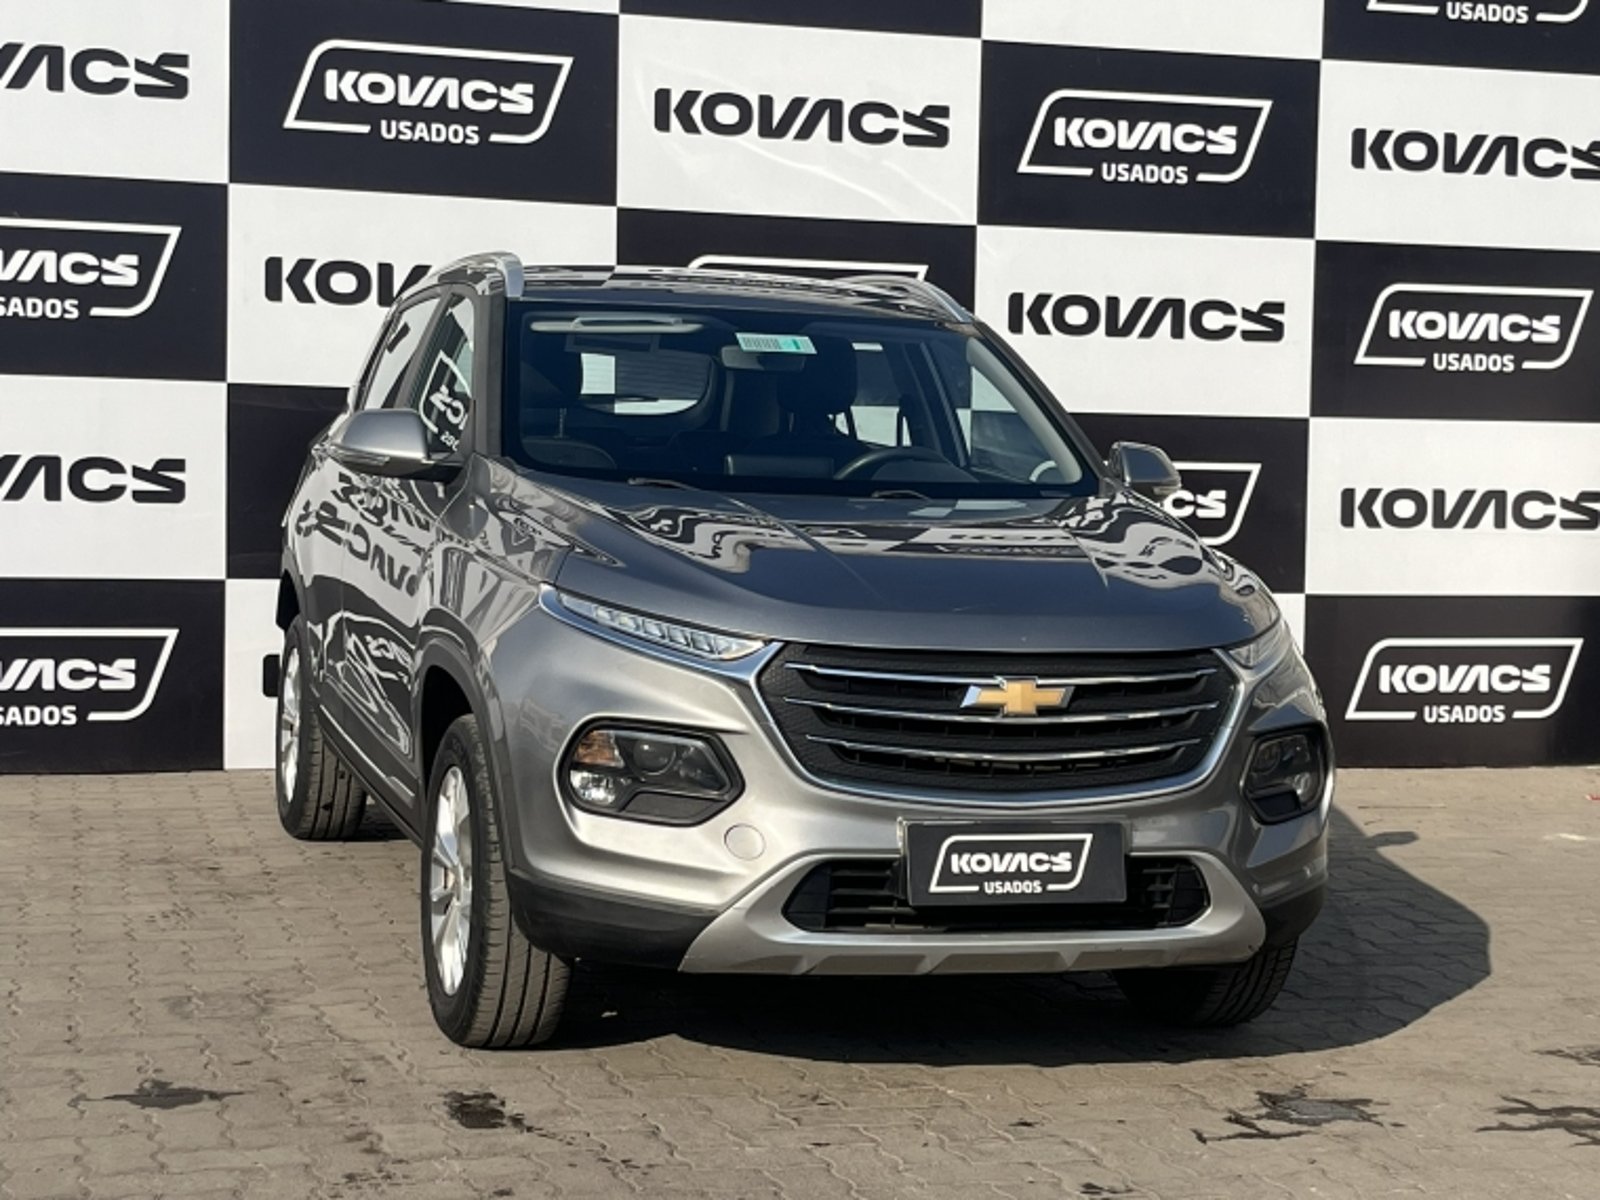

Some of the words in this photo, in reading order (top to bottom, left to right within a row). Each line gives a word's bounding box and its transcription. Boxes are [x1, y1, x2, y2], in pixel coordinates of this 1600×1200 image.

[1446, 2, 1529, 24] USADOS
[0, 42, 190, 100] ACS
[324, 69, 534, 114] KOVACS
[380, 119, 480, 145] USADOS
[654, 87, 950, 149] KOVACS
[1054, 117, 1237, 155] KOVACS
[1350, 127, 1600, 181] KOVACS
[1101, 162, 1189, 185] USADOS
[0, 248, 139, 287] VACS
[264, 256, 432, 308] KOV
[0, 296, 79, 319] ADOS
[1007, 292, 1286, 343] KOVACS
[1388, 309, 1561, 343] KOVACS
[1433, 352, 1515, 373] USADOS
[0, 454, 186, 504] ACS
[1340, 487, 1600, 531] KOVACS
[0, 658, 136, 691] VACS
[1379, 664, 1551, 693] KOVACS
[0, 705, 77, 726] ADOS
[1423, 704, 1506, 723] USADOS
[950, 851, 1073, 874] KOVACS
[983, 879, 1043, 895] USADOS
